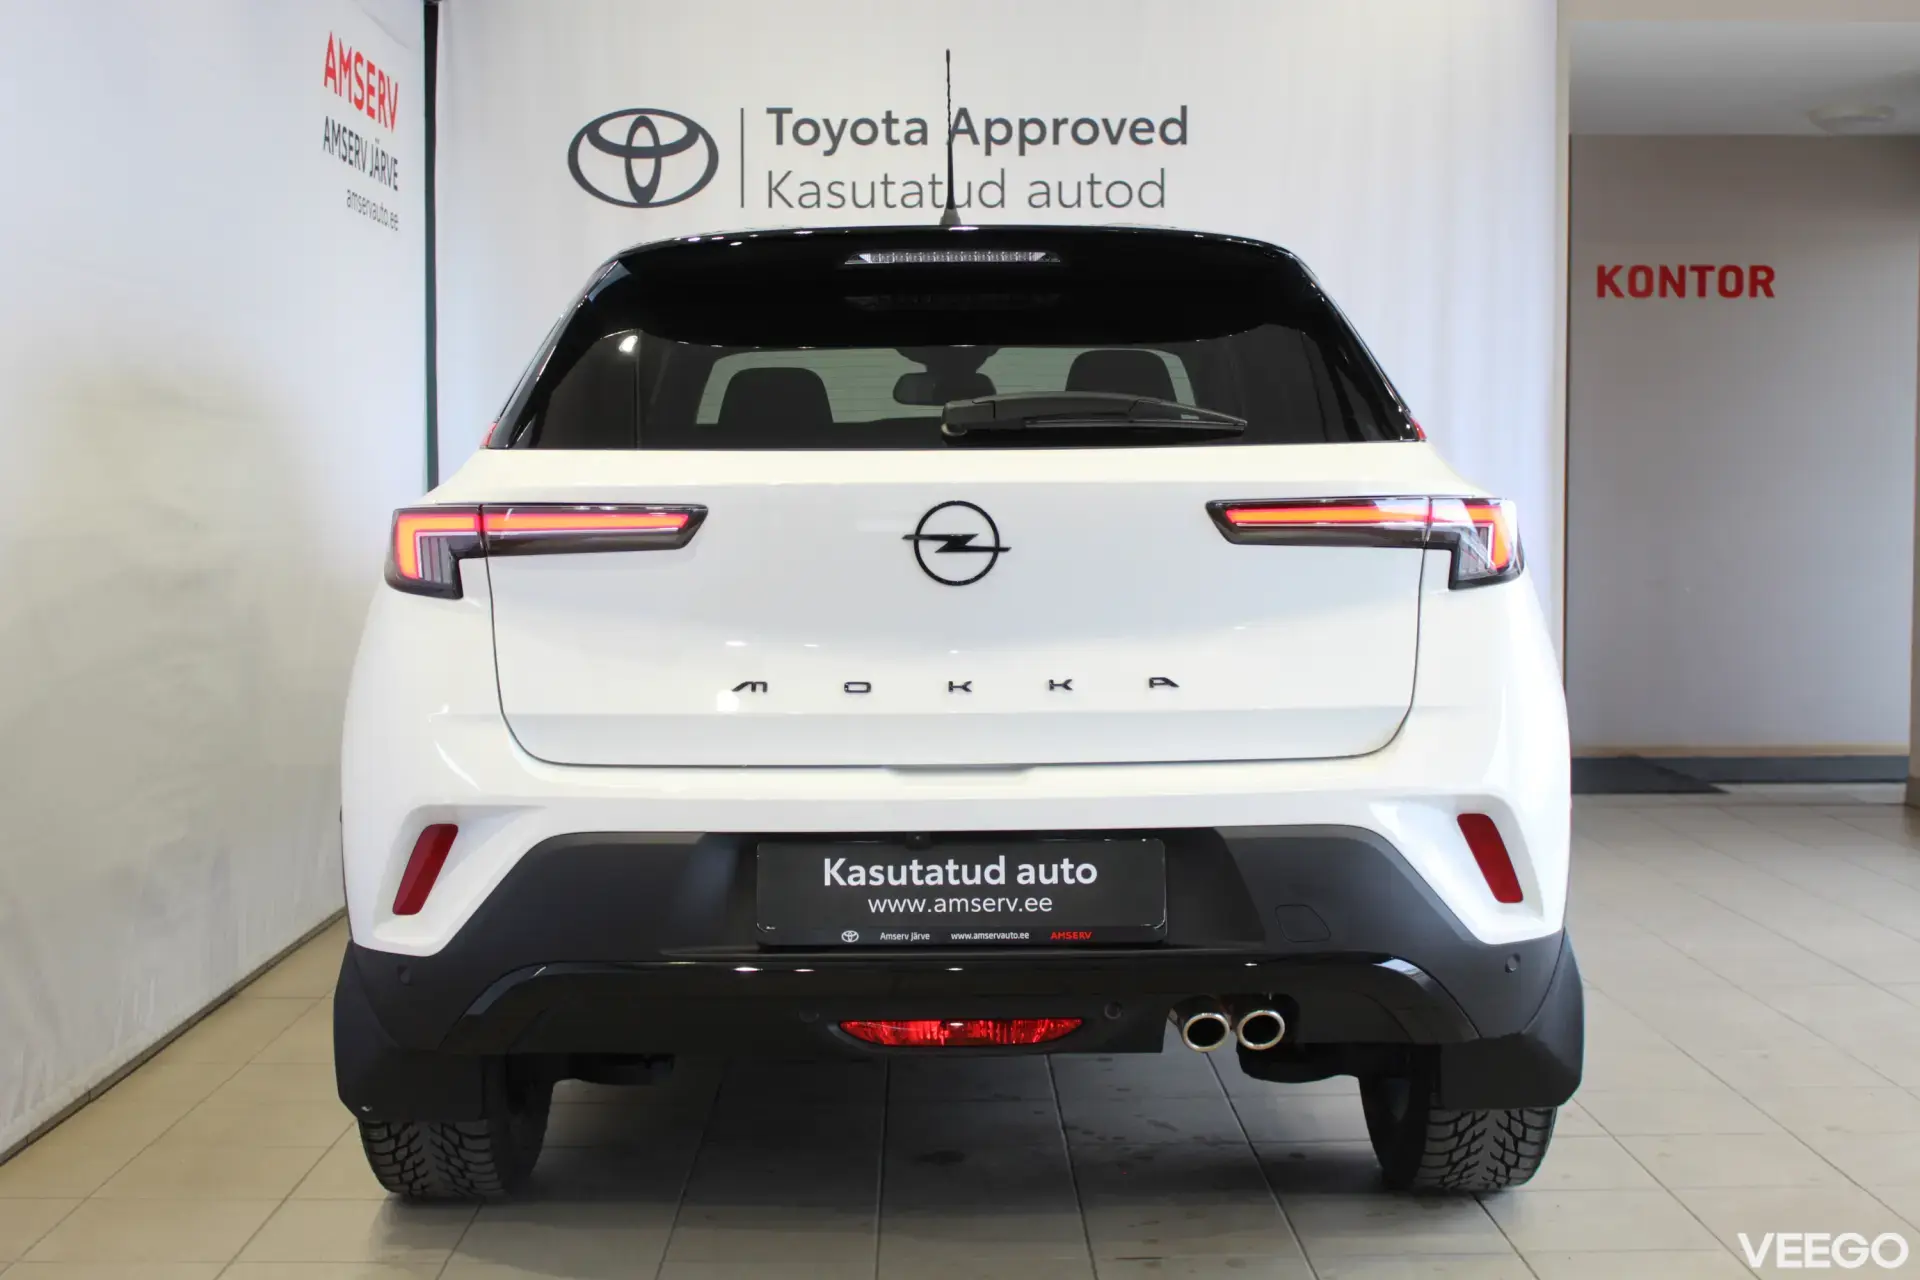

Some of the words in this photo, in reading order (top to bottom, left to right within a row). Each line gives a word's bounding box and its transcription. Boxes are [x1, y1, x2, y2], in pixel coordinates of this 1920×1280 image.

[324, 31, 398, 133] AMSERV
[766, 107, 929, 157] Toyota
[946, 105, 1188, 157] Approved
[323, 115, 368, 173] AMSERV
[369, 137, 399, 191] JÄRVE
[768, 168, 1005, 208] Kasutatud
[1028, 168, 1166, 208] autod
[346, 189, 399, 231] amservauto.ee
[1596, 264, 1775, 299] KONTOR
[732, 676, 1179, 694] MOKKA
[823, 855, 1006, 887] Kasutatud
[1016, 857, 1098, 885] auto
[867, 895, 1053, 914] www.amserv.ee
[879, 931, 909, 941] Amserv
[911, 931, 930, 942] Järve
[950, 931, 1030, 940] www.amservauto.ee
[1050, 931, 1093, 940] AMSERV
